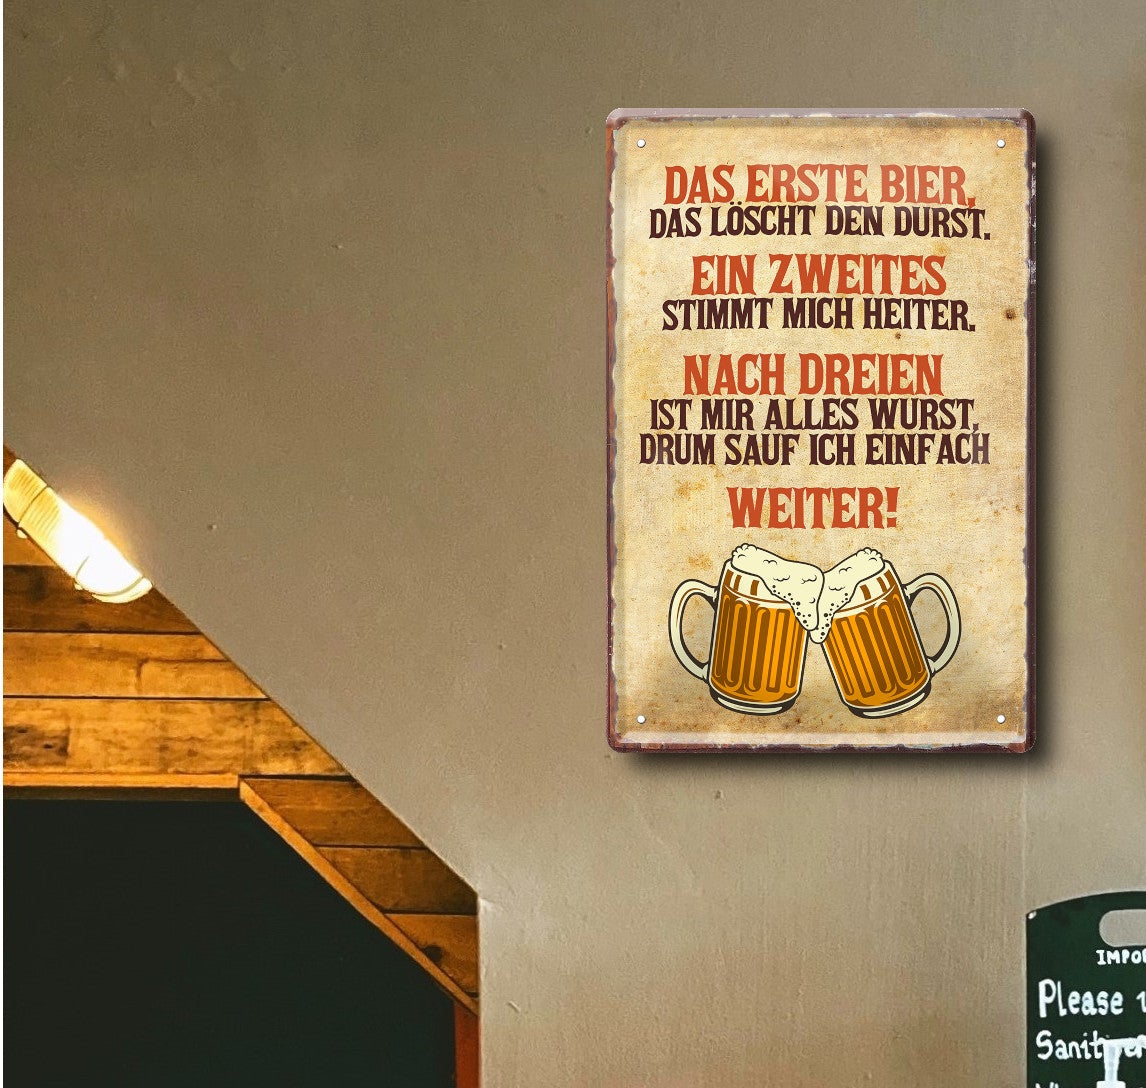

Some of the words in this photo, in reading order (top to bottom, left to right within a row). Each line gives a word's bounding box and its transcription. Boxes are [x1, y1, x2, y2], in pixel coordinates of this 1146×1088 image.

[664, 164, 735, 205] DAS
[745, 163, 869, 204] ERSTE
[879, 164, 976, 209] BIER,
[649, 207, 703, 239] DAS
[709, 200, 817, 237] LÖSCHT
[824, 205, 885, 237] DEN
[893, 206, 991, 241] DURST.
[691, 254, 757, 296] EIN
[768, 253, 948, 297] ZWEITES
[662, 297, 774, 331] STIMMT
[781, 297, 855, 330] MICH
[862, 297, 976, 332] HEITER.
[683, 353, 786, 397] NACH
[798, 353, 945, 397] DREIEN
[649, 398, 693, 431] IST
[700, 398, 755, 431] MIR
[763, 398, 859, 431] ALLES
[867, 397, 980, 433] WURST,
[639, 433, 716, 466] DRUM
[724, 433, 801, 467] SAUF
[808, 433, 856, 466] ICH
[865, 433, 991, 466] EINFACH
[726, 486, 900, 530] WEITER!
[1038, 978, 1124, 1018] Please
